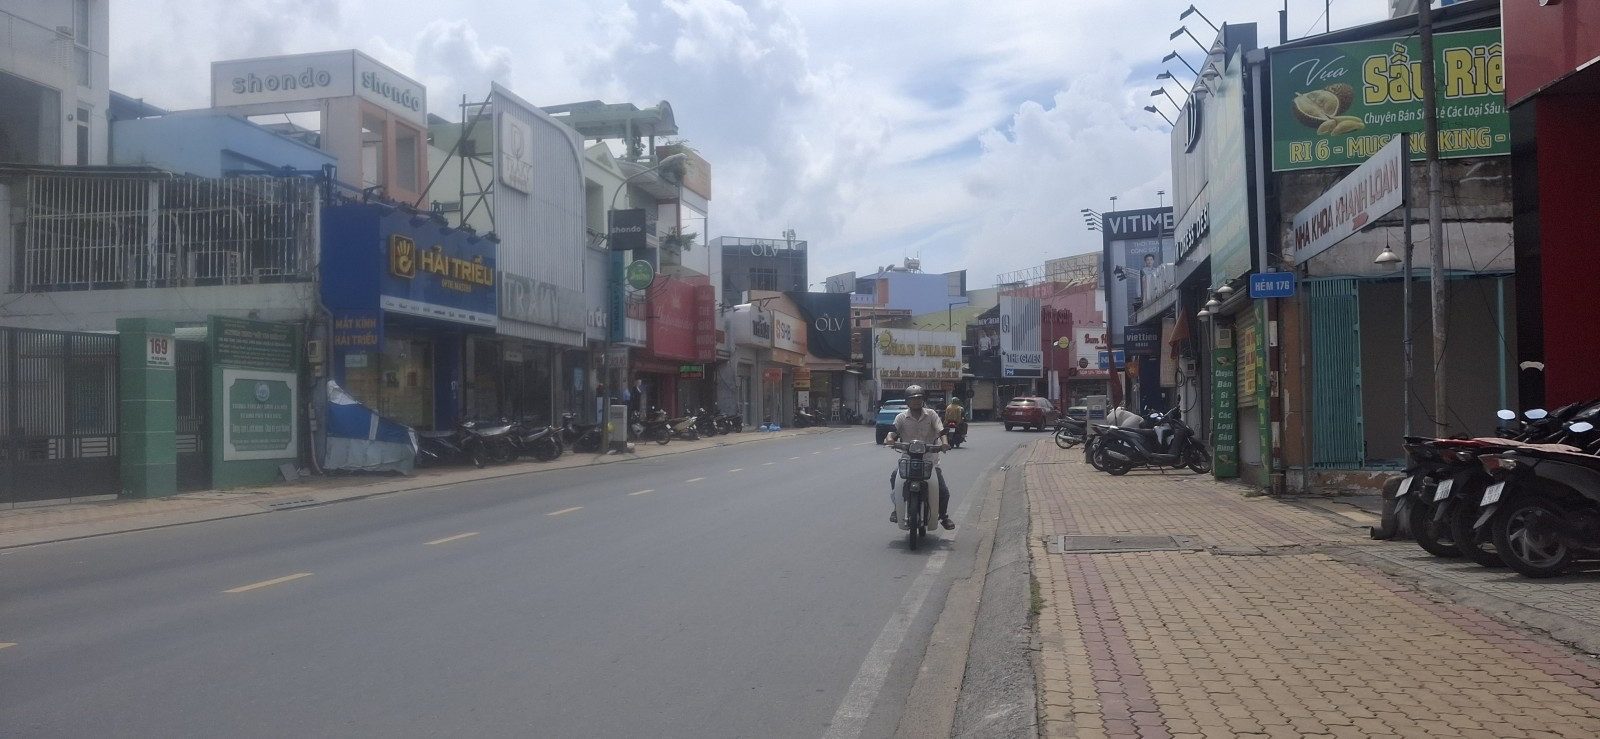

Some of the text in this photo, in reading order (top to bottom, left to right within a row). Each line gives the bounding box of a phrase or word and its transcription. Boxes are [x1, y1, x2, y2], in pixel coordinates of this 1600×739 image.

[231, 66, 331, 94] shondo
[361, 70, 420, 112] shondo
[1364, 111, 1396, 126] Chuyên
[1398, 109, 1415, 121] Bán
[1447, 106, 1462, 118] Các
[1464, 104, 1483, 119] Loại
[1290, 141, 1312, 163] RI
[1314, 139, 1331, 161] 6
[1347, 130, 1430, 159] MUSNG
[1439, 127, 1492, 152] KING
[1311, 205, 1334, 242] KHOA
[1369, 157, 1398, 206] LOAN
[612, 225, 642, 234] shondo
[421, 245, 449, 275] HẢI
[1275, 280, 1290, 290] 176
[150, 337, 168, 355] 169
[1126, 332, 1158, 342] viettien
